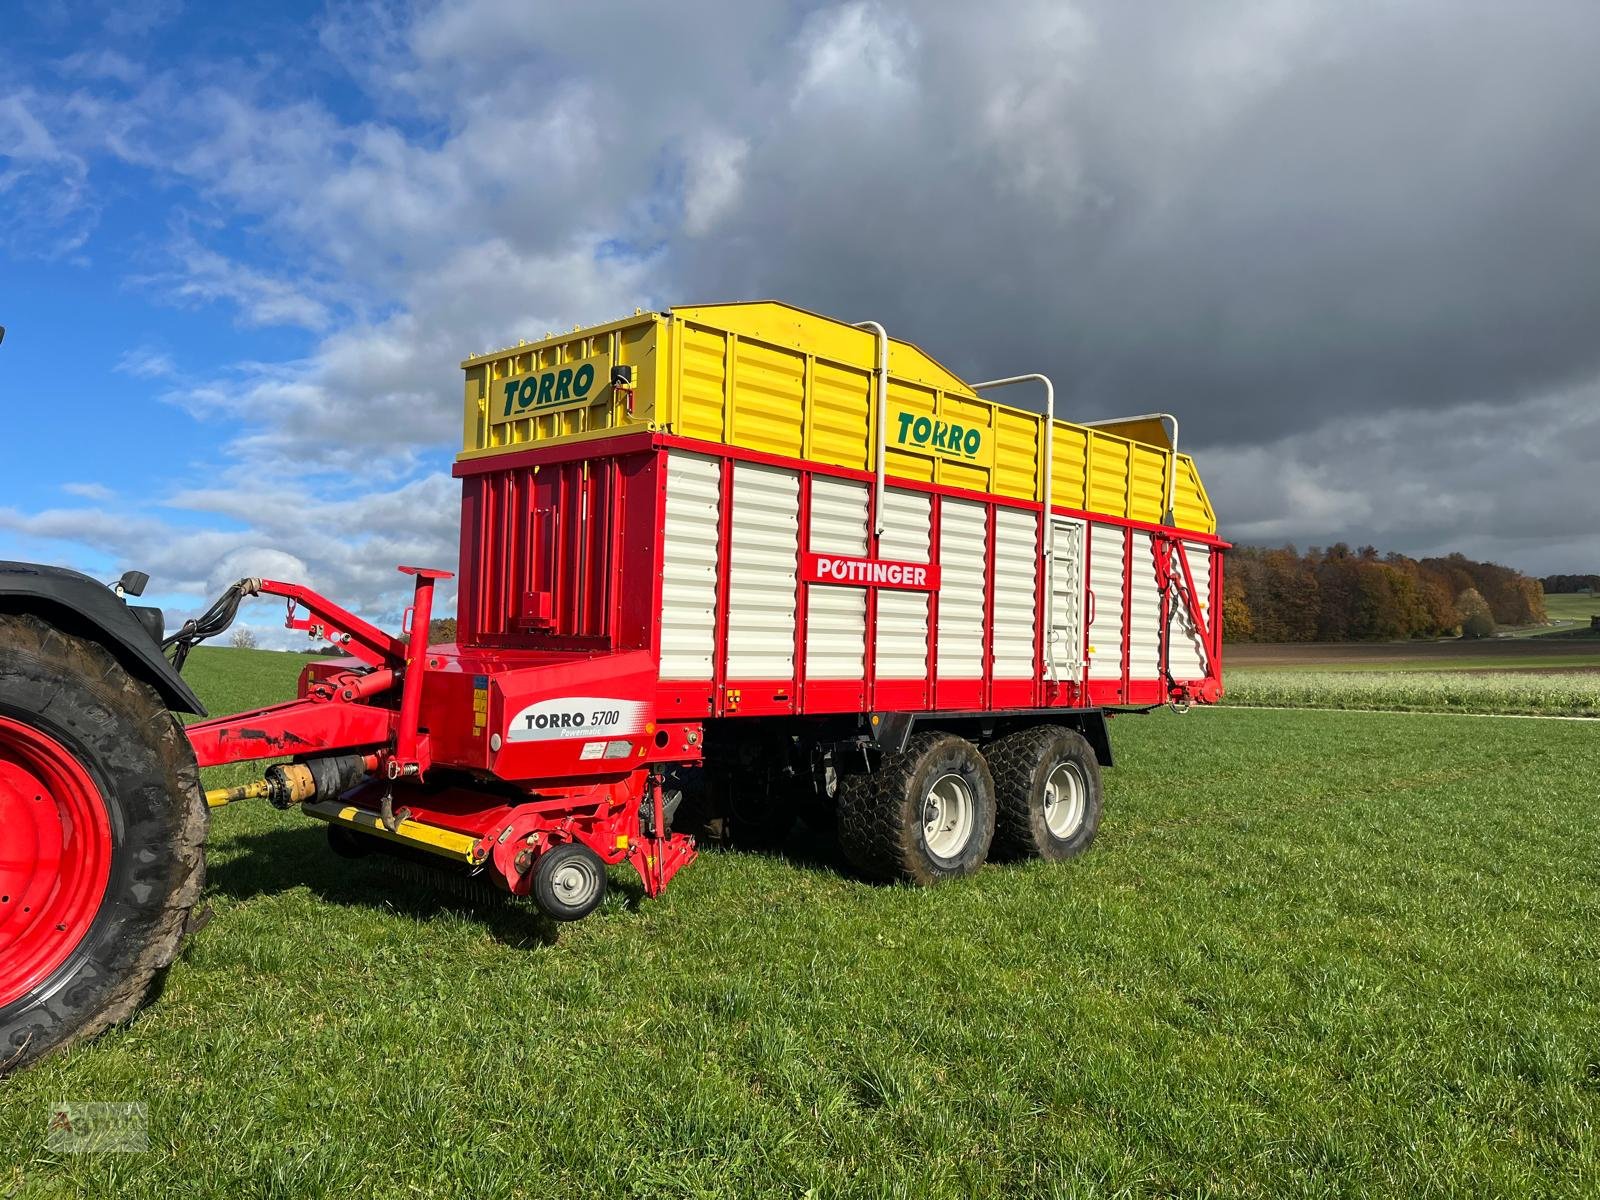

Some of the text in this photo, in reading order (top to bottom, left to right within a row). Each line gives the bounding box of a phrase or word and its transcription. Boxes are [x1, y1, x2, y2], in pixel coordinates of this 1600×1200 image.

[503, 363, 595, 417] TORRO
[897, 411, 981, 455] TORRO
[816, 557, 927, 586] PÖTTINGER
[525, 710, 620, 730] TORRO 5700
[560, 728, 602, 737] Powermatic
